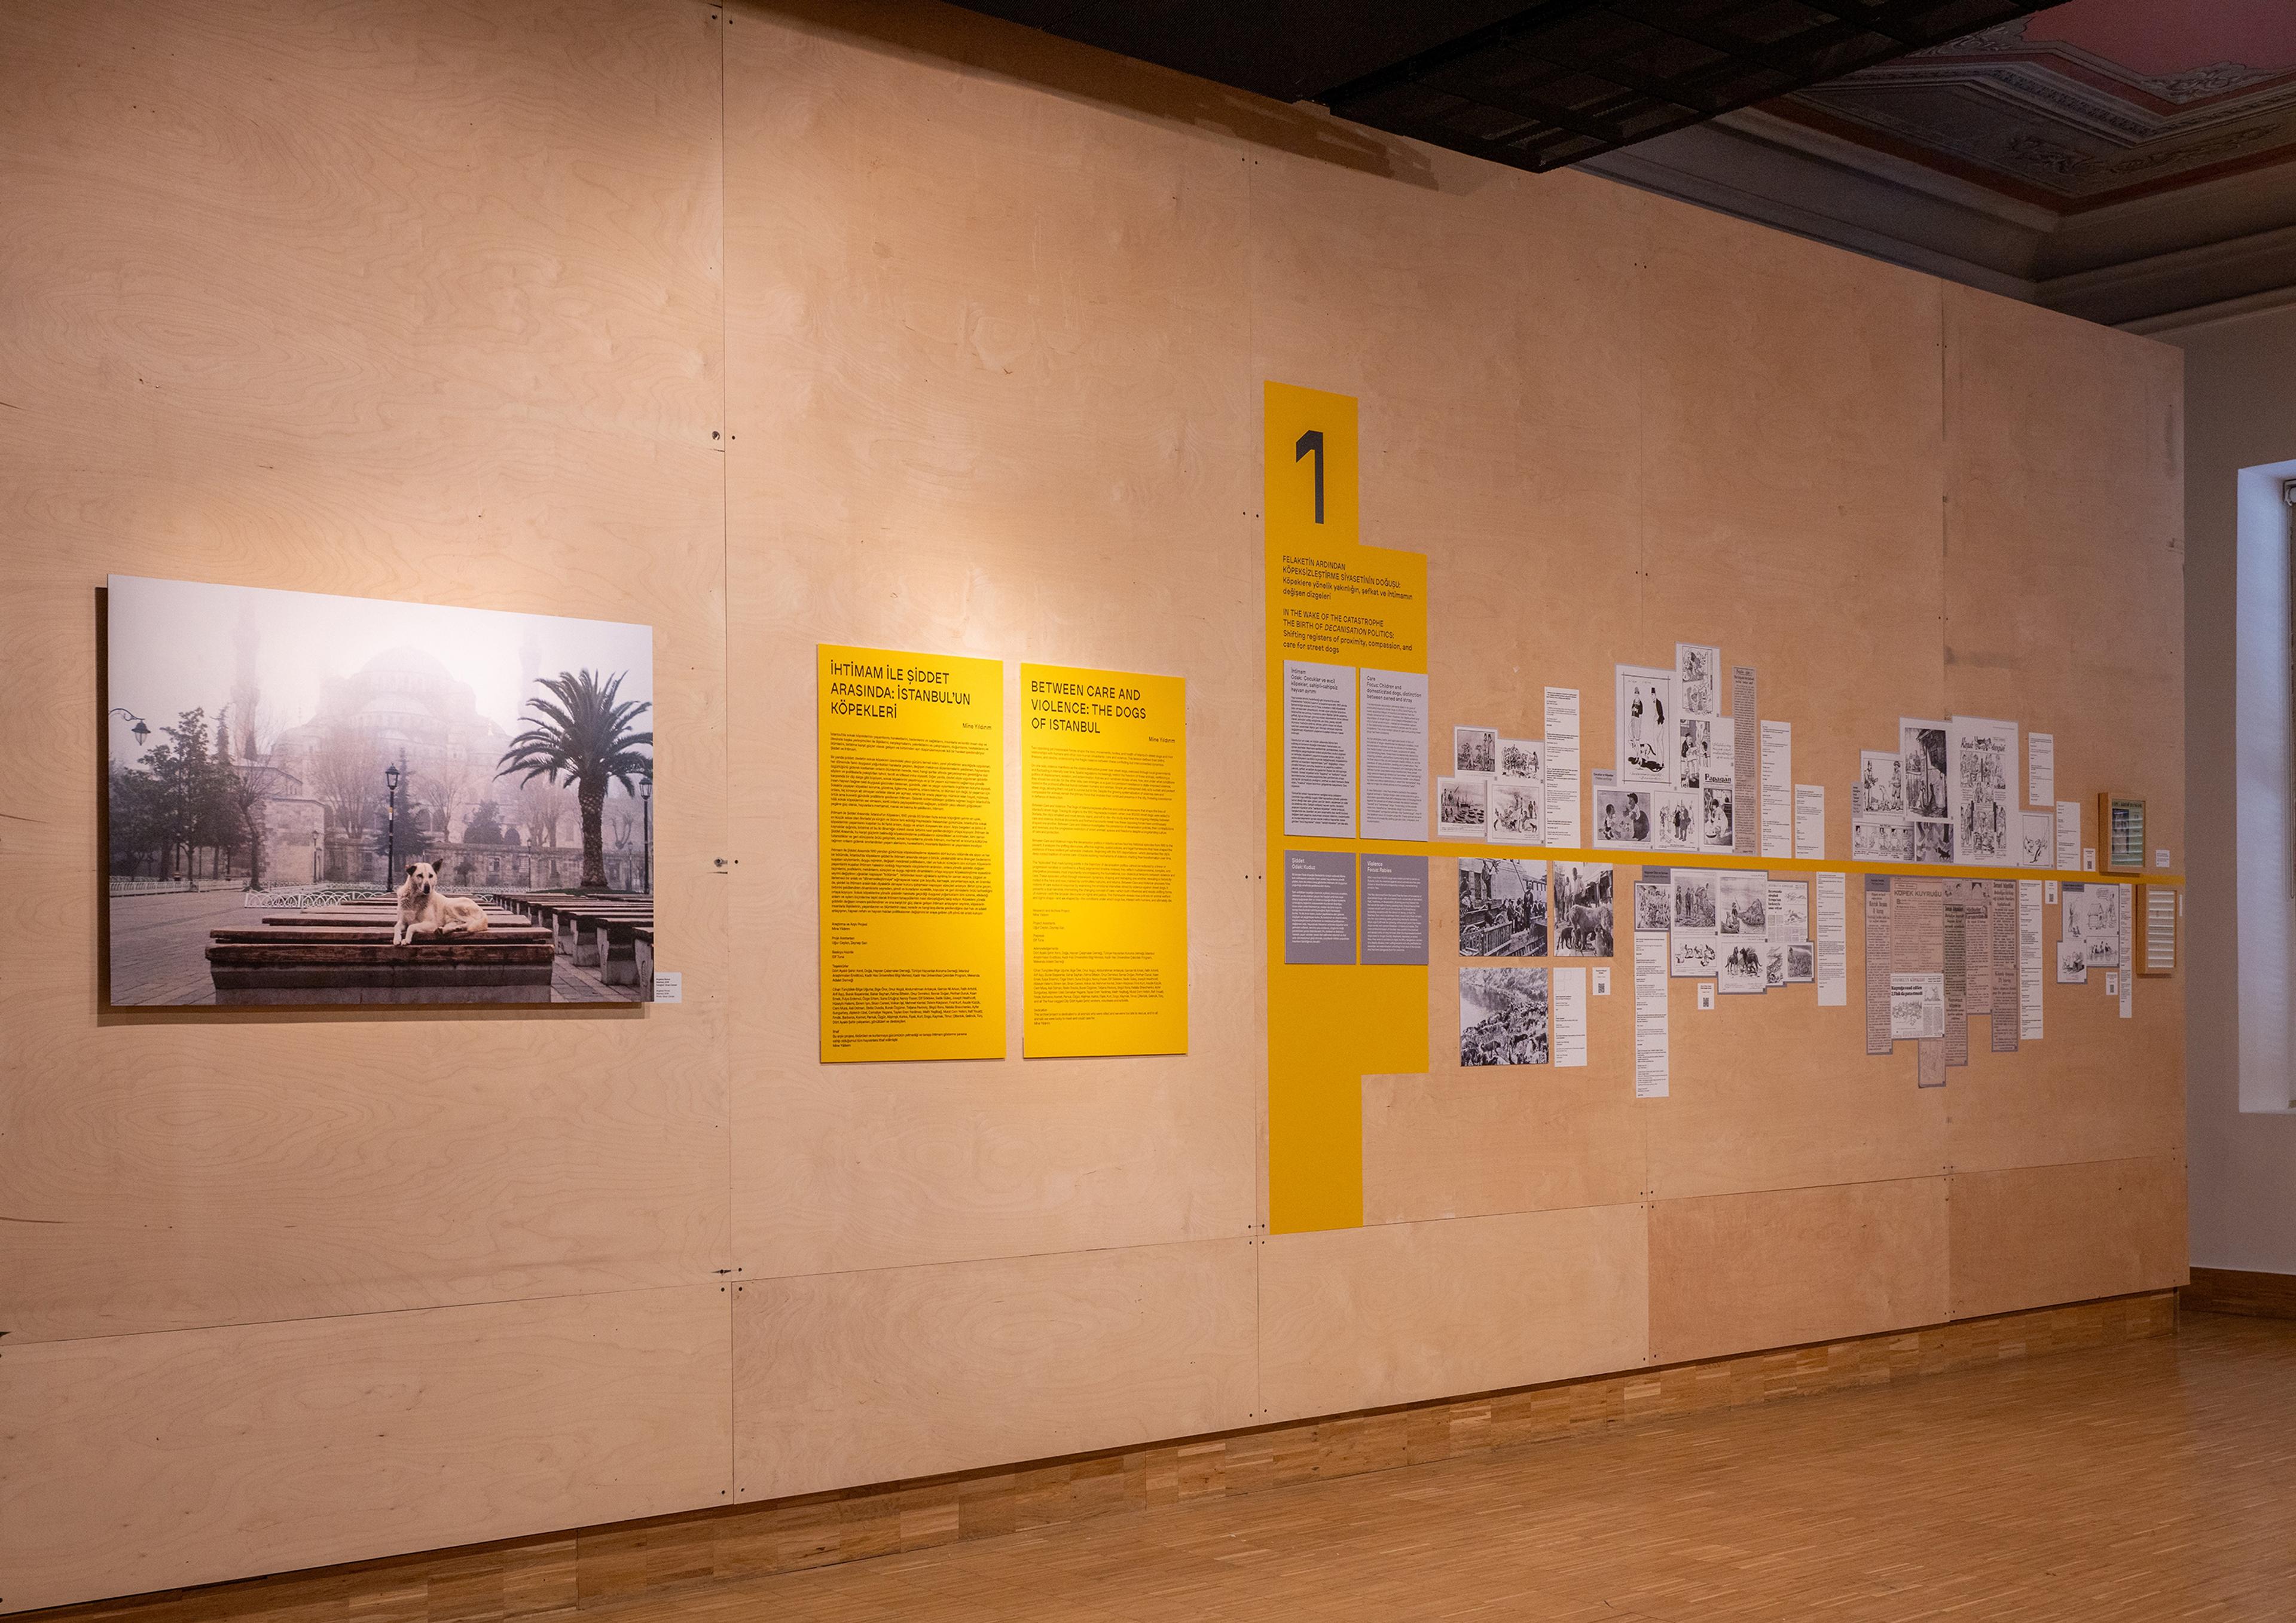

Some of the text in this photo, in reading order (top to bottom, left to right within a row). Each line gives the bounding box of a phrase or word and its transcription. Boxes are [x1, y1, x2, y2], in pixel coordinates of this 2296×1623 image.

[1296, 430, 1324, 524] 1
[1283, 555, 1345, 570] FELAKETİN ARDINDAN
[1283, 565, 1401, 588] KÖPEKSİZLEŞTİRME SİYASETİNİN DOĞUŞU:
[1283, 577, 1311, 587] Köpeklere
[1333, 583, 1360, 594] yakınlığın,
[1361, 587, 1379, 596] şefkat
[1388, 590, 1412, 600] ihtimamın
[1283, 588, 1331, 600] değişen dizgeleri
[1303, 611, 1320, 619] WAKE
[1344, 616, 1384, 626] CATASTROPHE
[1296, 621, 1314, 629] BIRTH
[1325, 624, 1367, 635] DECANISATION
[1367, 628, 1394, 638] POLITICS:
[1283, 630, 1305, 640] Shifting
[1306, 634, 1332, 642] registers
[1341, 637, 1367, 647] proximity,
[1369, 640, 1402, 650] compassion,
[1326, 645, 1339, 653] dogs
[831, 659, 949, 685] İHTİMAM İLE ŞİDDET
[831, 683, 894, 699] ARASINDA:
[1031, 681, 1141, 701] BETWEEN CARE AND
[831, 699, 897, 719] KÖPEKLERİ
[1031, 699, 1146, 719] VIOLENCE: THE DOGS
[1031, 718, 1101, 733] OF ISTANBUL
[1704, 774, 1732, 783] Papagan
